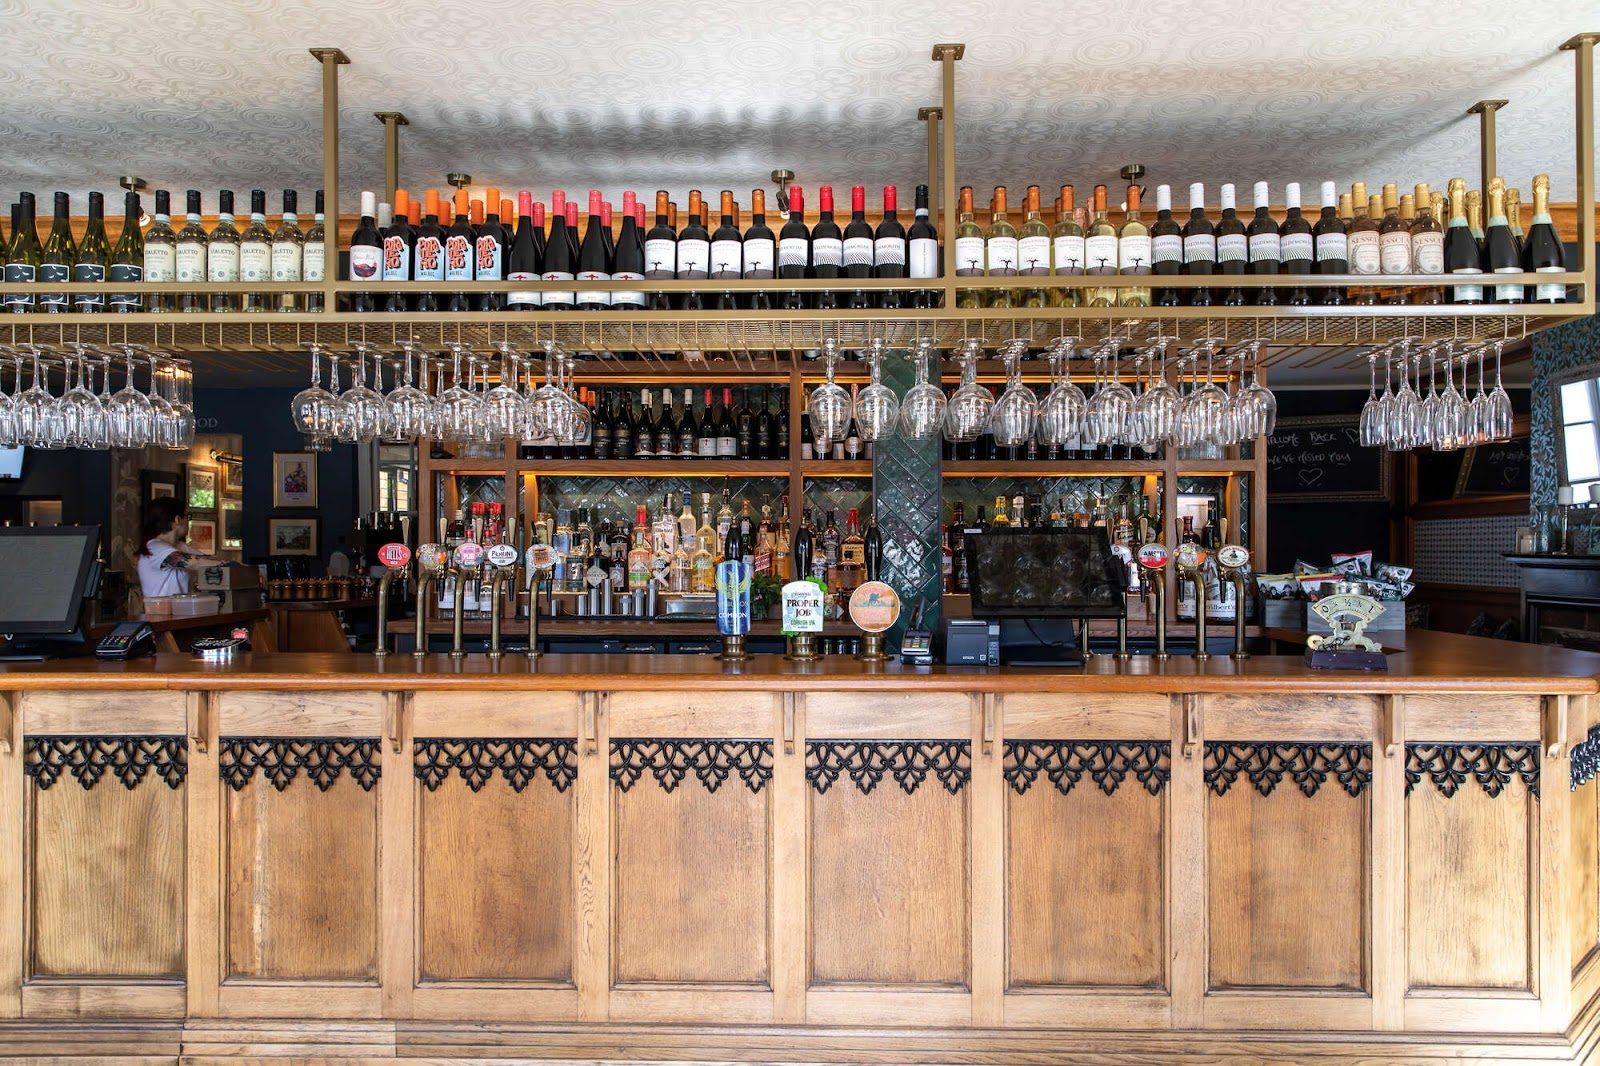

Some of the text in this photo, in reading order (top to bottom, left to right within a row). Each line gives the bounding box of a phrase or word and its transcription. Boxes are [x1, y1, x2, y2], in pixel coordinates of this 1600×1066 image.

[1268, 431, 1337, 447] ELCOME BACK
[1327, 451, 1352, 463] YOU
[786, 599, 819, 608] PROPER
[795, 608, 812, 618] JOB
